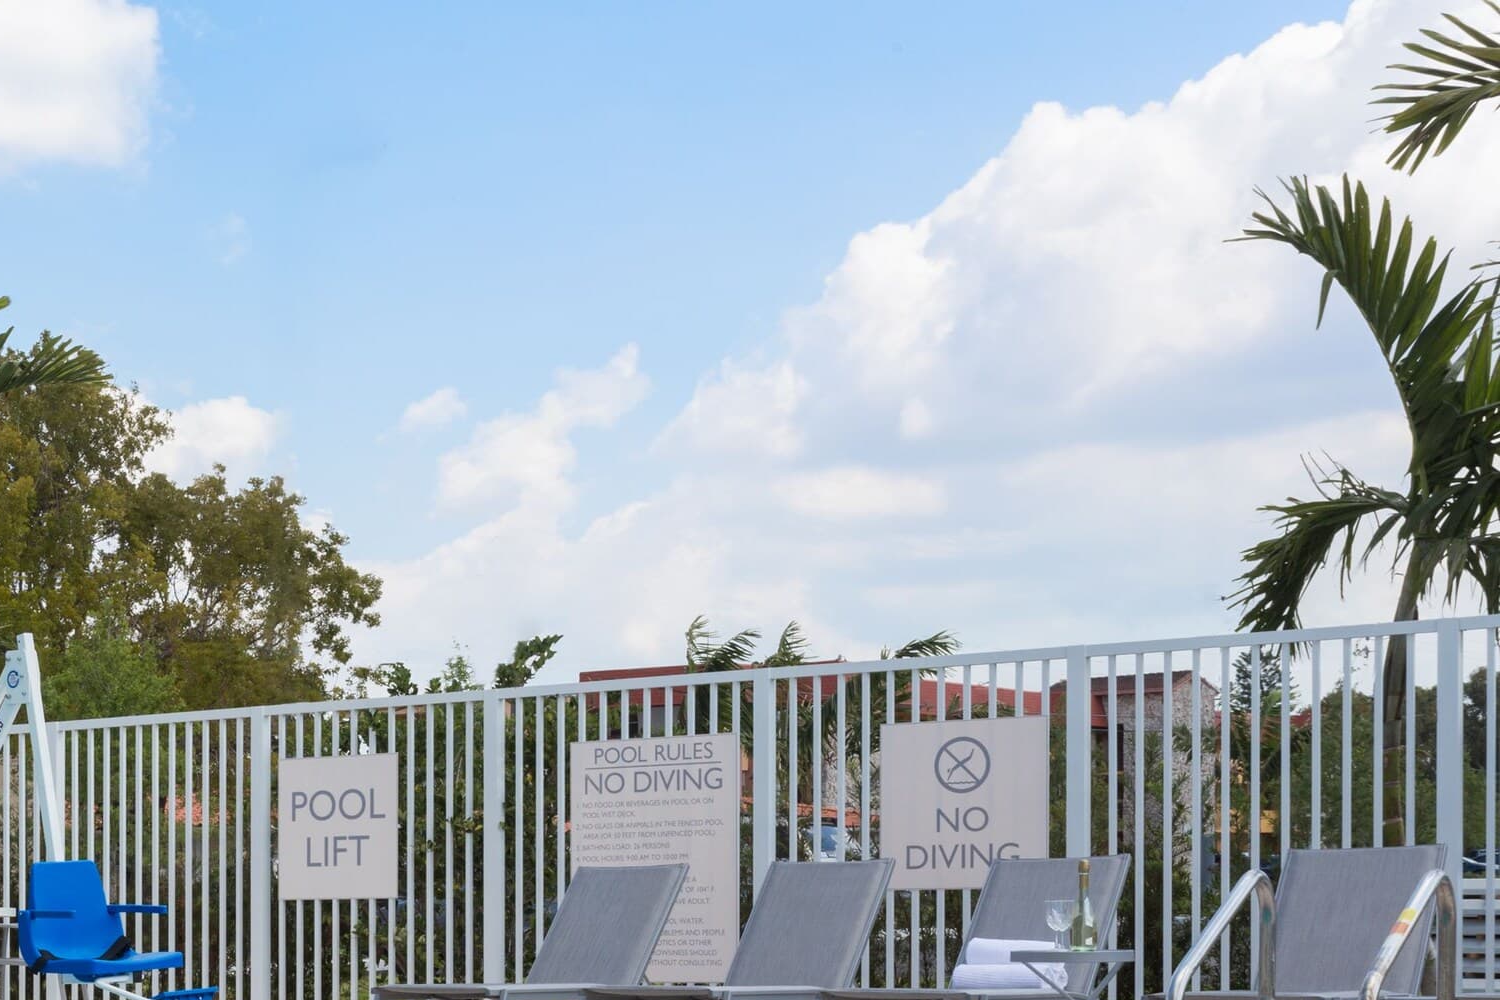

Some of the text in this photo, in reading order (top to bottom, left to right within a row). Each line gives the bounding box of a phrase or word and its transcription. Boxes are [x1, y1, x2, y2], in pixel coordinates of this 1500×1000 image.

[595, 742, 713, 764] POOL RULES
[585, 767, 723, 795] NO DIVING
[291, 788, 386, 822] POOL
[936, 806, 989, 833] NO
[658, 830, 693, 838] UNFENCED
[306, 835, 370, 867] LIFT
[906, 842, 1021, 870] DIVING
